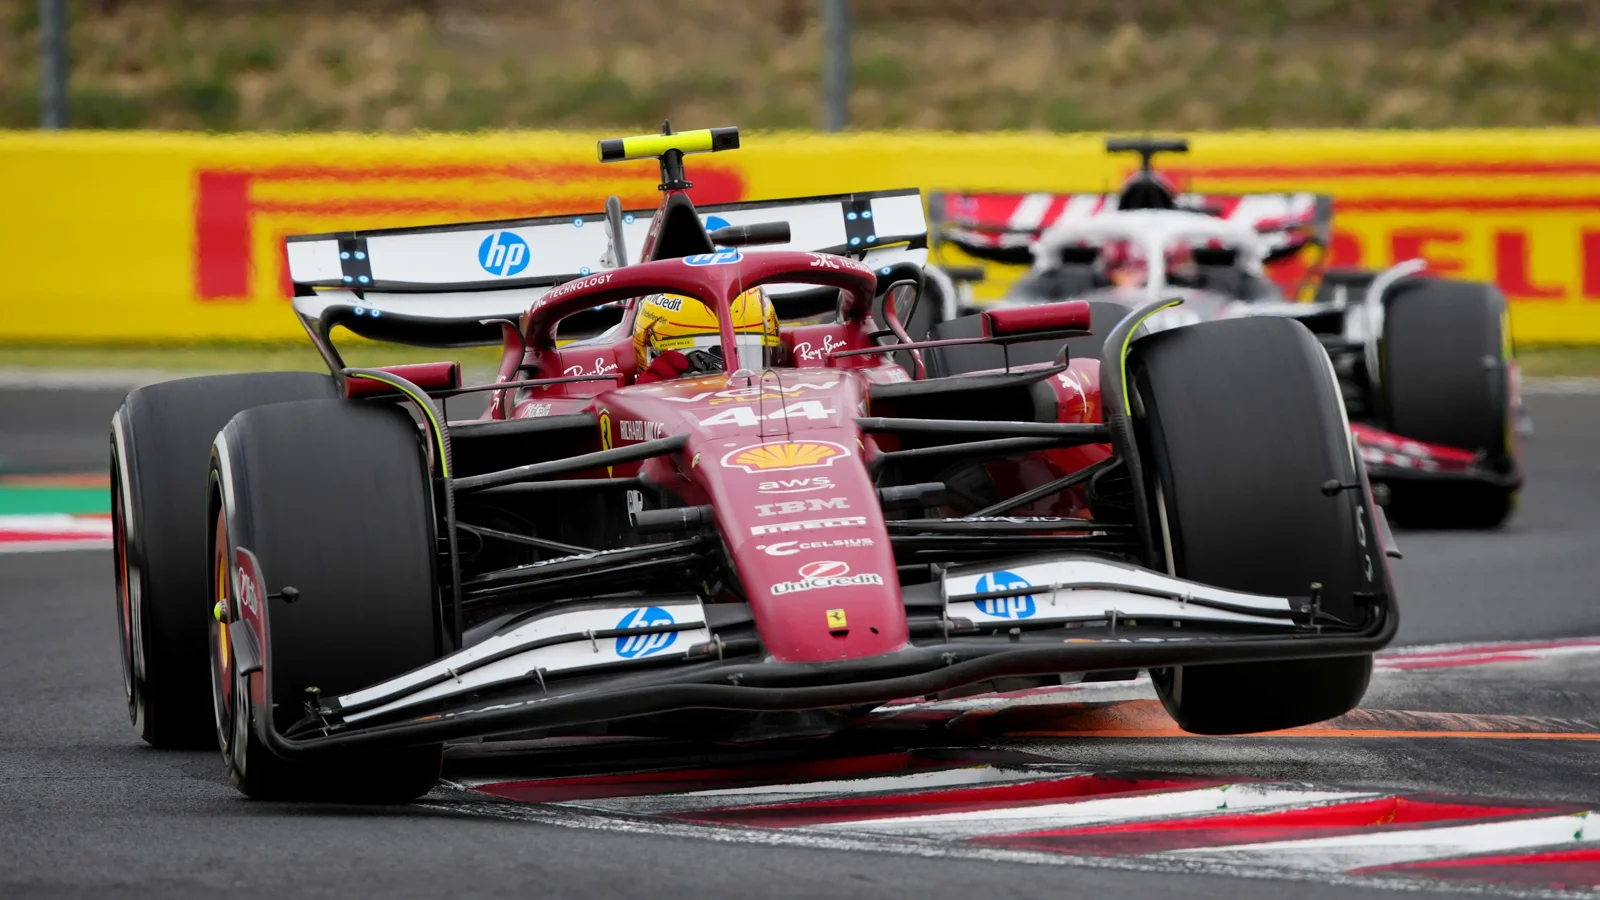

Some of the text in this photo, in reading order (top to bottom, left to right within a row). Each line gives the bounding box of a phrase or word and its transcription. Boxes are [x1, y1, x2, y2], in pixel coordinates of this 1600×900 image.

[481, 231, 528, 276] hp
[549, 273, 613, 299] TECHNOLOGY
[793, 334, 848, 361] Ray-Ban
[662, 380, 840, 402] VGW
[709, 390, 807, 406] PLAY
[699, 400, 837, 428] 44
[619, 419, 643, 441] RICHARD
[757, 476, 833, 492] aws
[754, 496, 851, 517] IBM
[750, 516, 867, 535] PIRELLI
[799, 537, 874, 549] CELSIUS
[772, 573, 883, 595] UniCredit
[977, 571, 1034, 618] hp
[619, 606, 675, 658] hp
